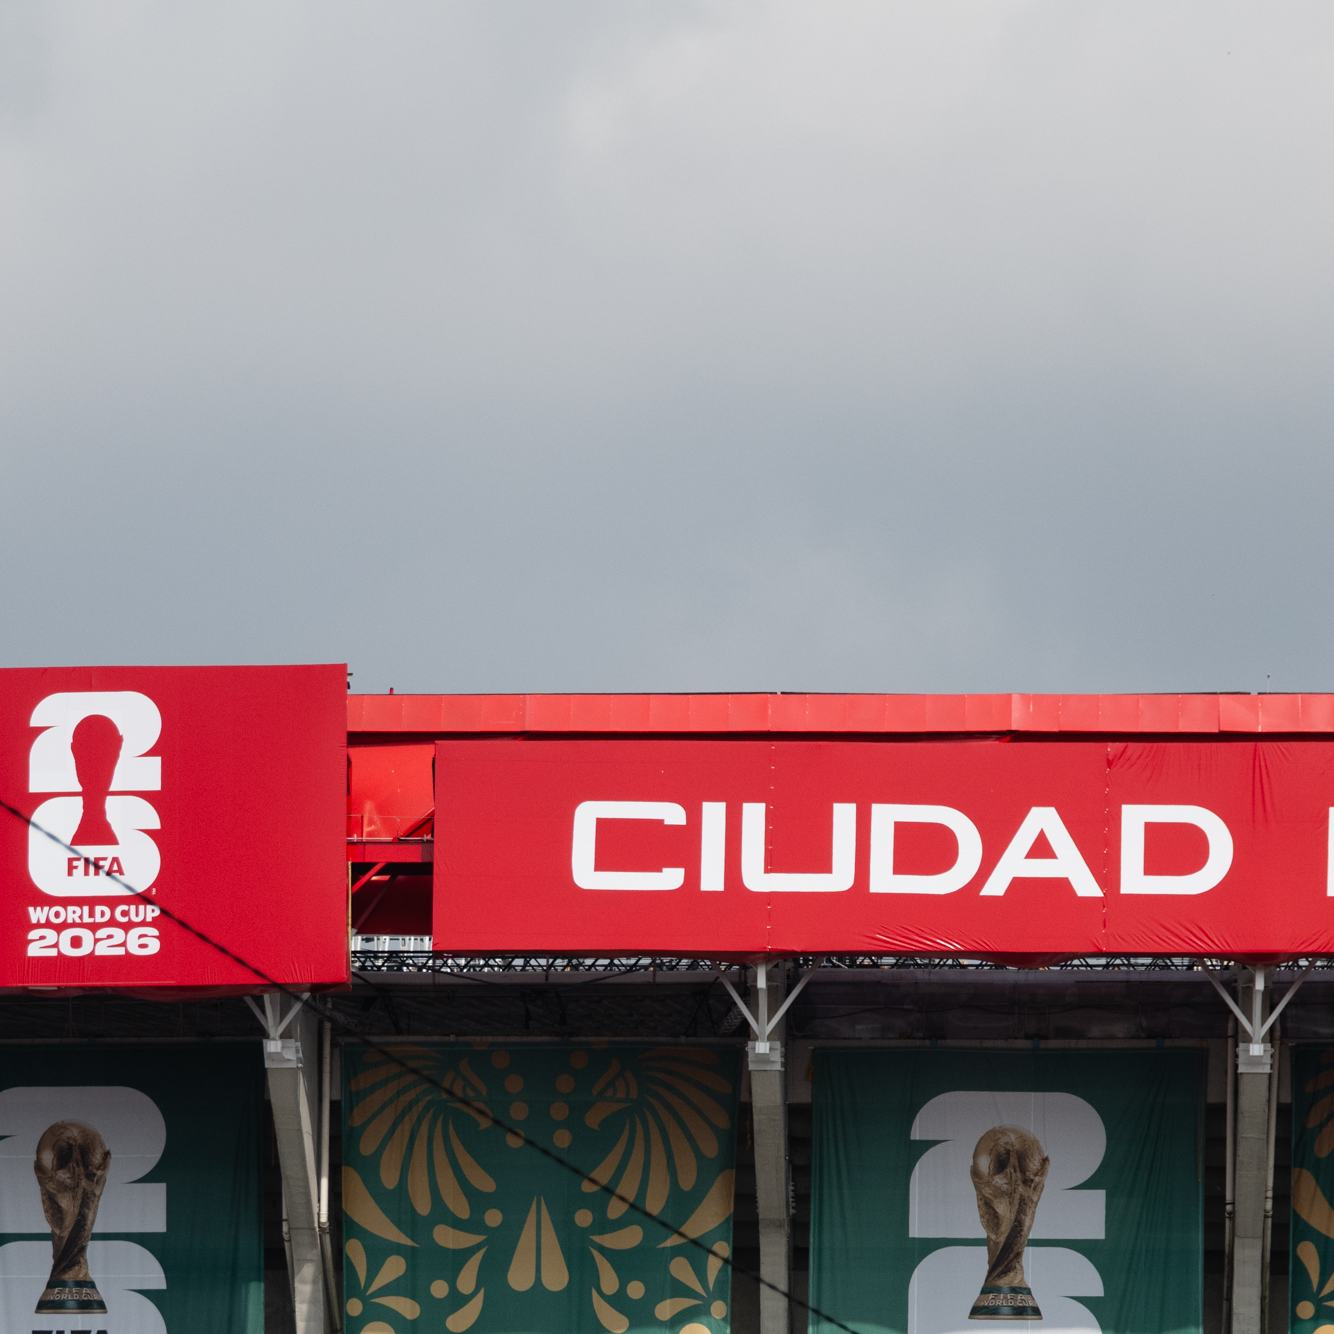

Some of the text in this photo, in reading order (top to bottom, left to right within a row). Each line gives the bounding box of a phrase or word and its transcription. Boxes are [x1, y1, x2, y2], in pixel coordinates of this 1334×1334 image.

[571, 801, 1234, 897] CIUDAD
[67, 856, 125, 877] FIFA
[28, 904, 161, 924] WORLD CUP
[27, 926, 161, 957] 2026
